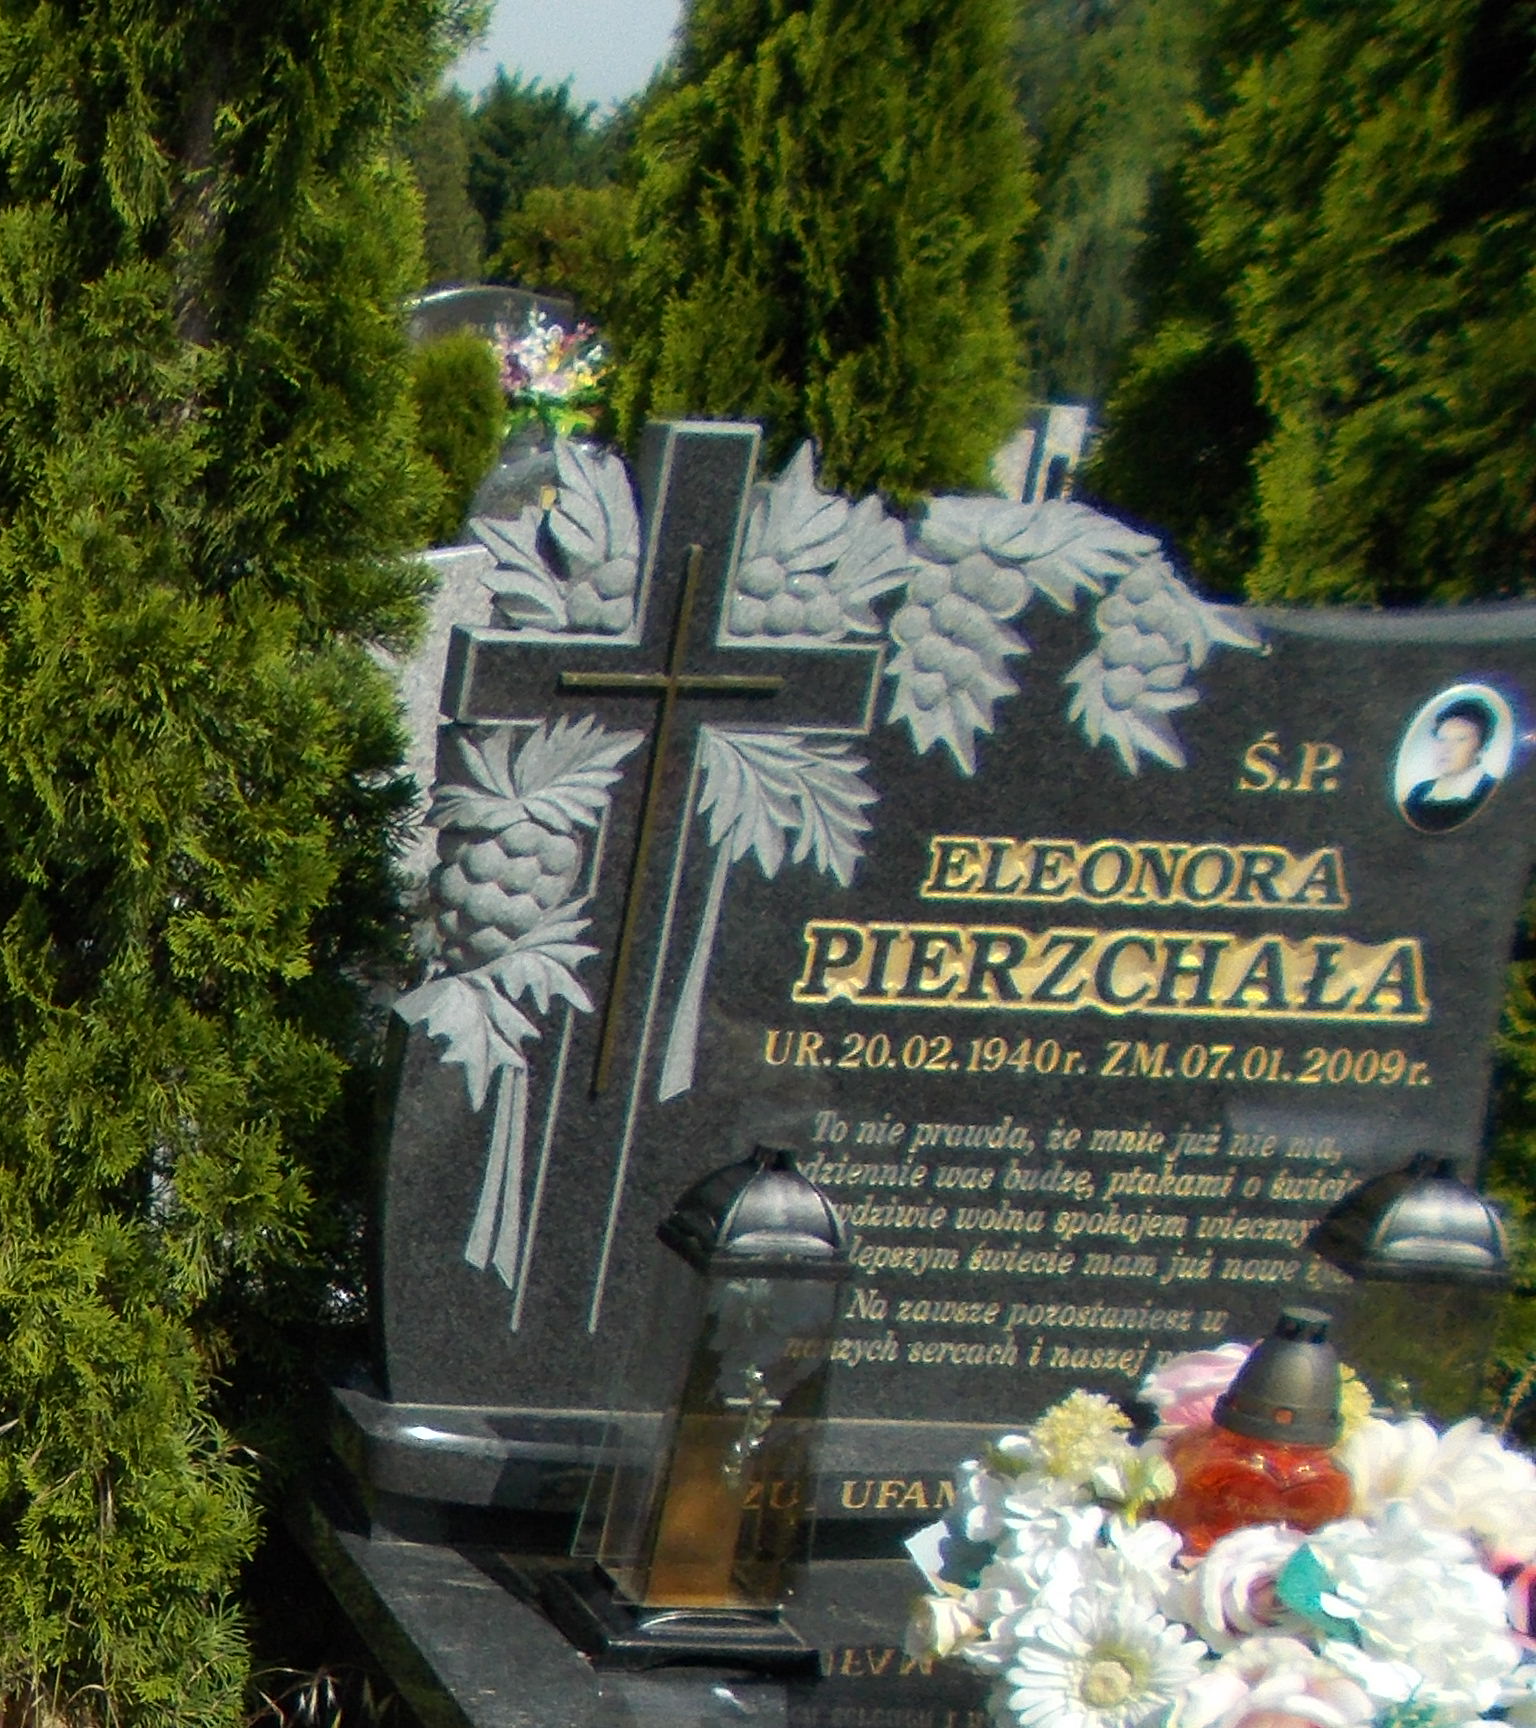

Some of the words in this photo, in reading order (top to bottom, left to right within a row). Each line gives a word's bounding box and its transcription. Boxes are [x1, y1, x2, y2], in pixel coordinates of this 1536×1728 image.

[1238, 730, 1344, 793] Ś.P.
[921, 834, 1350, 910] ELEONORA
[793, 918, 1430, 1023] PIERZCHAŁA
[812, 1110, 849, 1143] To
[856, 1112, 907, 1145] nie
[907, 1115, 1036, 1155] prawda,
[1046, 1117, 1082, 1150] że
[1088, 1121, 1166, 1154] mnie
[1164, 1123, 1222, 1162] już
[1229, 1126, 1278, 1158] nie
[796, 1150, 928, 1188] dziennie
[936, 1164, 997, 1190] was
[1100, 1160, 1238, 1200] ptakami
[1242, 1175, 1263, 1199] o
[831, 1194, 948, 1230] wdziwie
[954, 1199, 1046, 1233] wolna
[1052, 1202, 1189, 1243] spokojem
[1198, 1207, 1321, 1249] wieczny
[848, 1236, 961, 1276] lepszym
[969, 1240, 1076, 1275] świecie
[1082, 1251, 1158, 1278] mam
[1222, 1255, 1302, 1283] nowe
[845, 1287, 889, 1322] Na
[896, 1299, 1002, 1326] zawsze
[1005, 1300, 1196, 1333] pozostaniesz
[1202, 1310, 1230, 1335] w
[785, 1329, 901, 1369] nazych
[907, 1330, 1020, 1367] sercach
[1027, 1334, 1046, 1367] i
